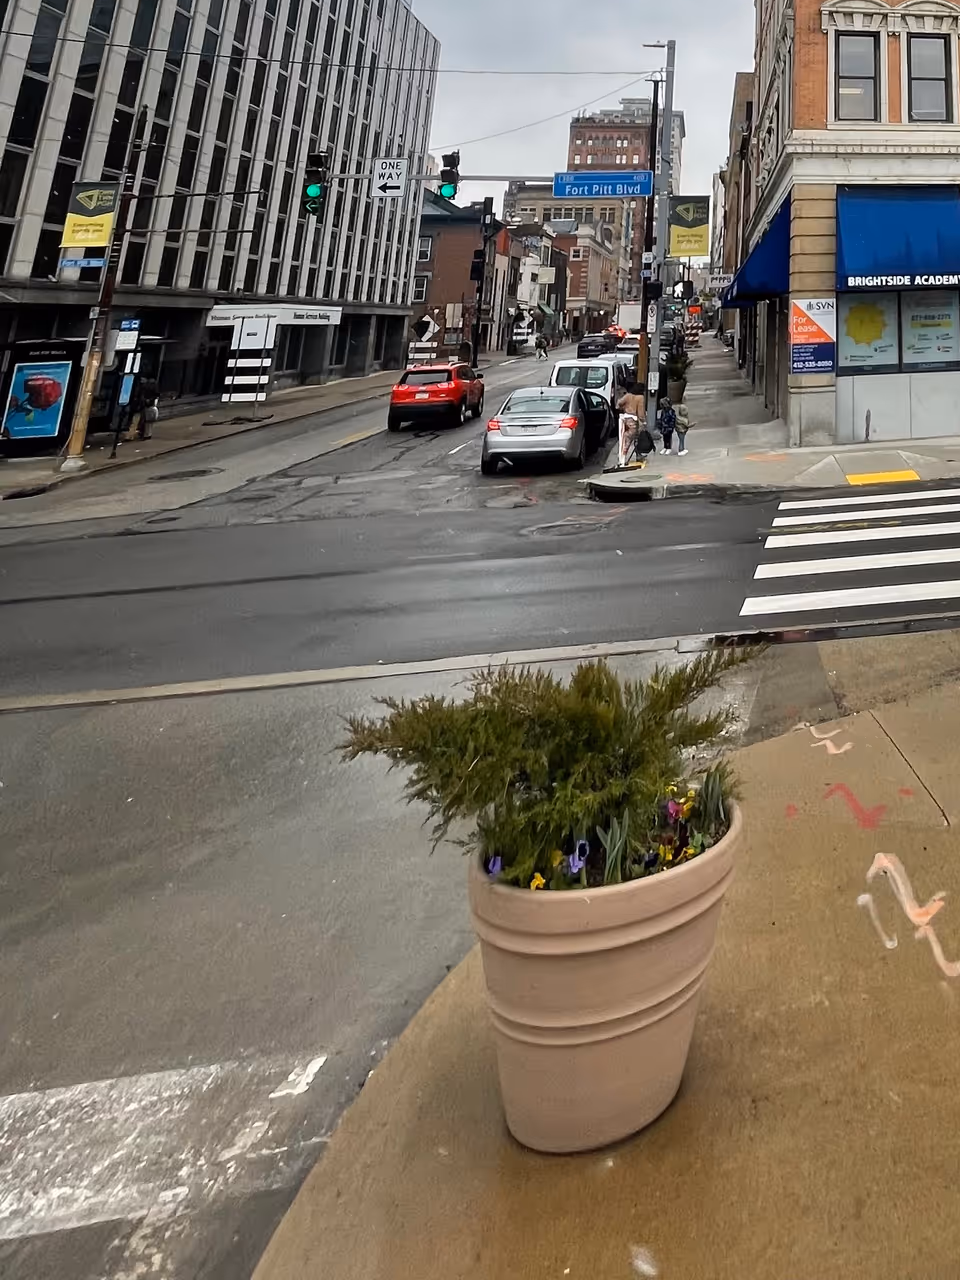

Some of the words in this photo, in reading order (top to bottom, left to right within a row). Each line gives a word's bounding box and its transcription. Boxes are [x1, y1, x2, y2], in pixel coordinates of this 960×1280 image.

[381, 161, 401, 170] ONE
[378, 172, 402, 180] WAY
[565, 185, 589, 195] Fort
[592, 184, 612, 195] Pitt
[616, 183, 641, 194] Blvd
[847, 276, 911, 287] BRIGHTSIDE
[815, 301, 835, 311] SVN
[793, 315, 808, 324] For
[793, 324, 818, 333] Lease
